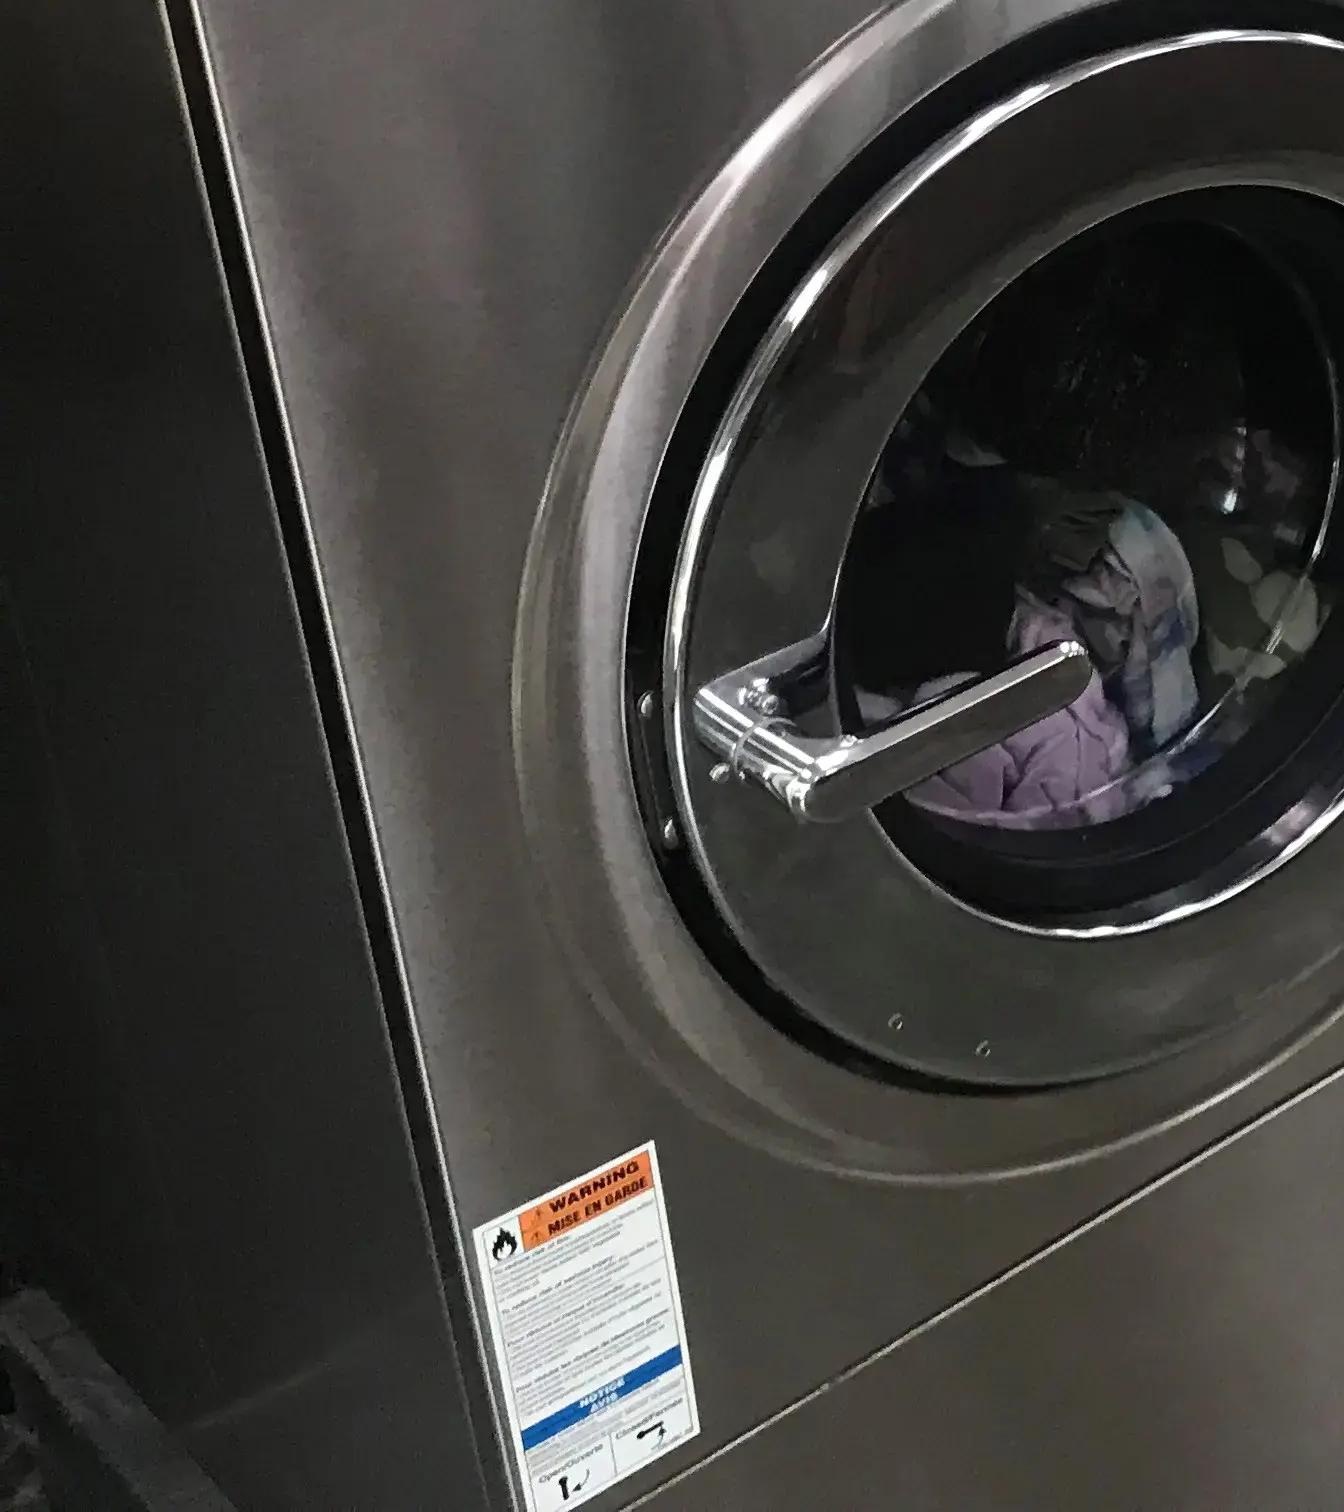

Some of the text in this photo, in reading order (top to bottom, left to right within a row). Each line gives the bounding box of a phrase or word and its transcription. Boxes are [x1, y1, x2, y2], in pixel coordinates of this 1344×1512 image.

[547, 1174, 647, 1236] MISE EN GARDE
[548, 1158, 639, 1214] WARNING
[579, 1376, 625, 1408] NOTICE
[589, 1391, 618, 1413] AVIS
